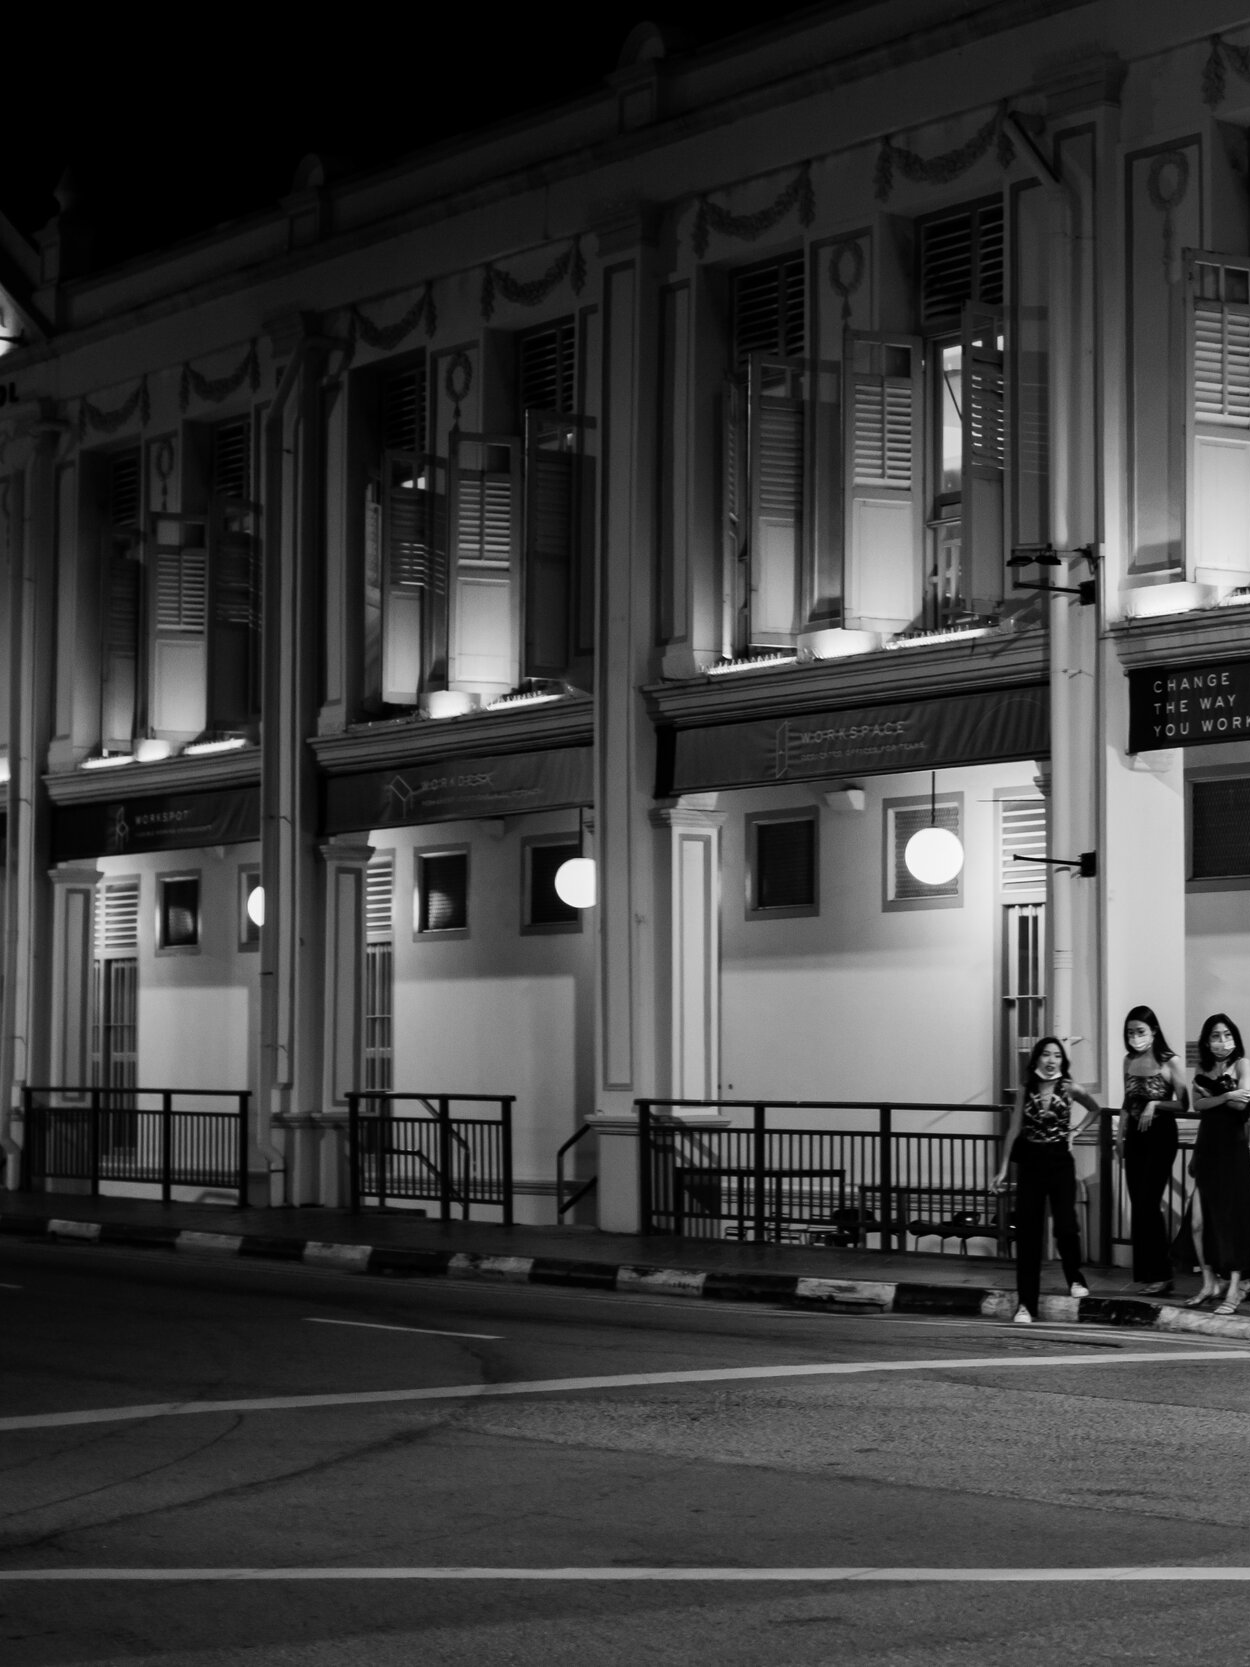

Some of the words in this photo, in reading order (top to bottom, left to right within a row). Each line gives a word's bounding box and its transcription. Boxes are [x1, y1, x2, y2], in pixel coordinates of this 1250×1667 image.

[1153, 672, 1230, 693] CHANGE
[1153, 699, 1189, 715] THE
[1199, 694, 1237, 710] WAY
[800, 721, 905, 744] WORKSPACE
[1153, 721, 1190, 737] YOU
